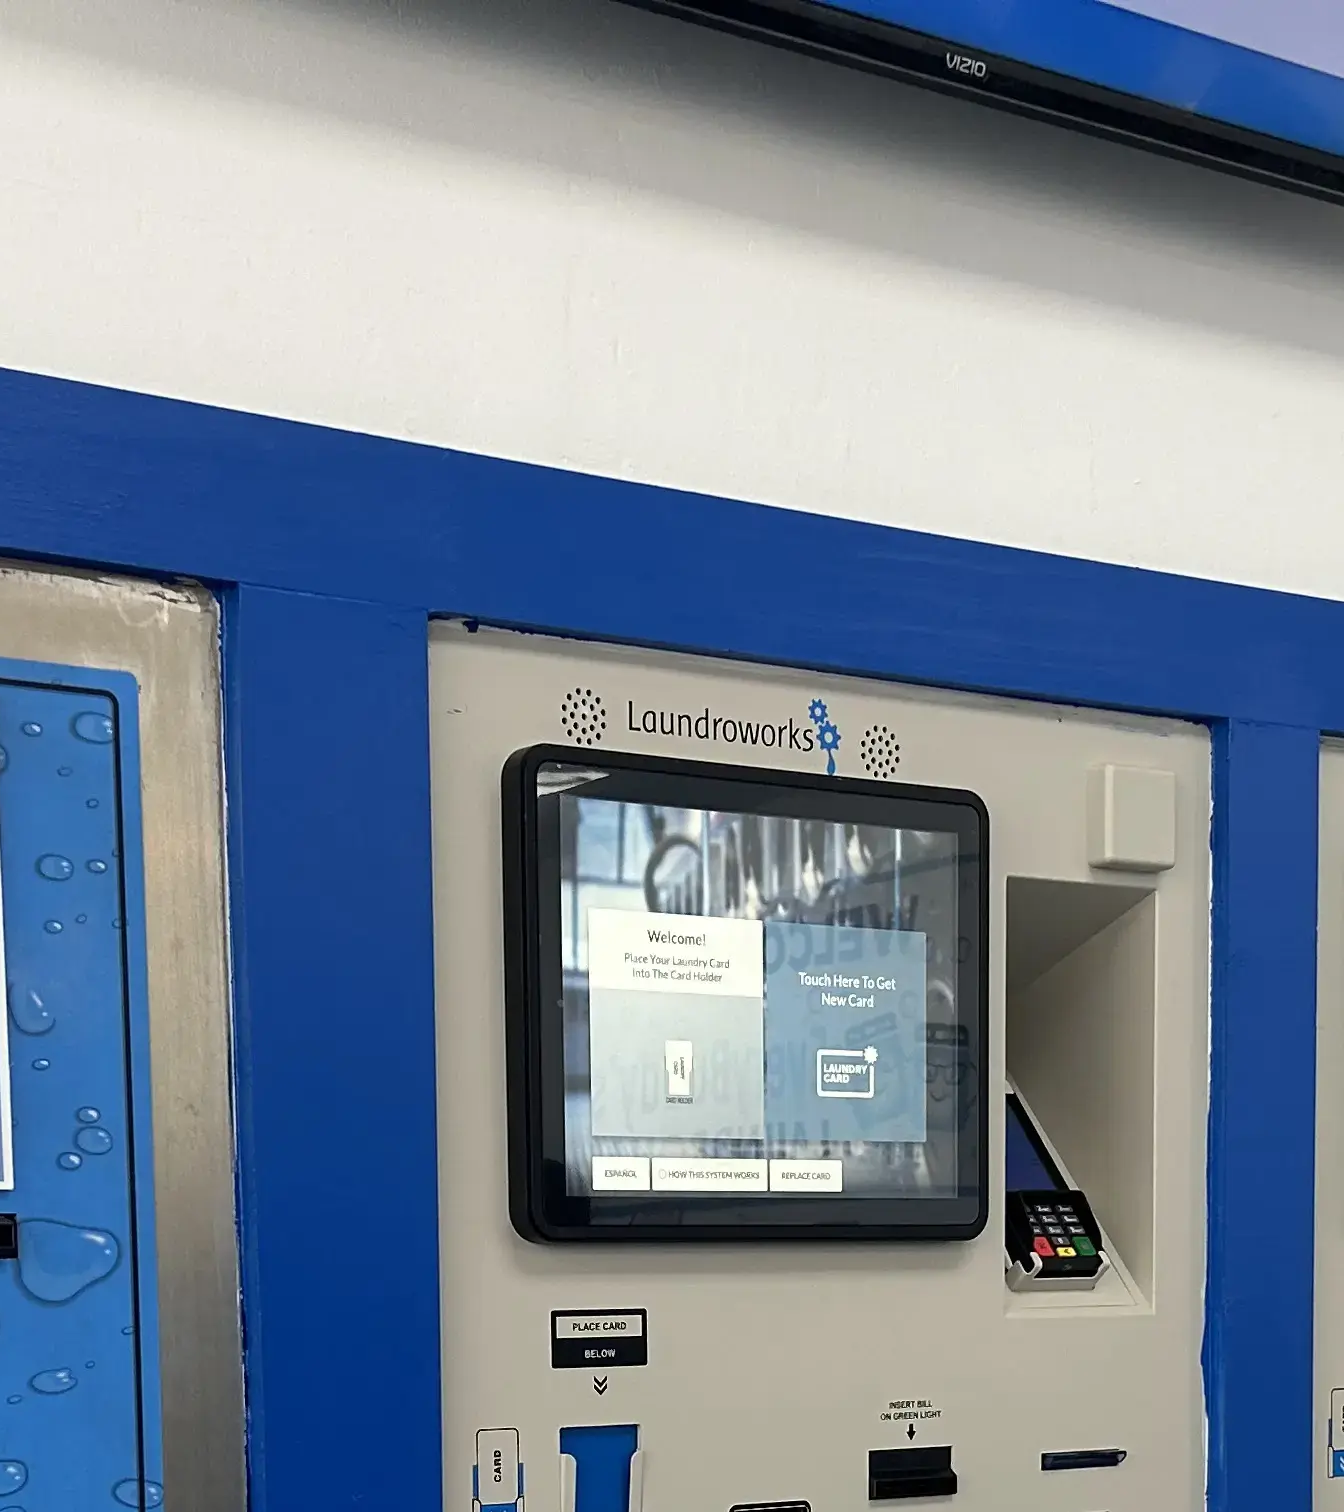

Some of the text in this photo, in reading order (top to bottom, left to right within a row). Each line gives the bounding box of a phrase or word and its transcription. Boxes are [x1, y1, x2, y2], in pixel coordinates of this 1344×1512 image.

[946, 52, 986, 77] VIZIO
[627, 700, 814, 753] Laundroworks
[647, 929, 706, 946] Welcome!
[624, 953, 730, 969] Place Your Laundry Card
[632, 968, 722, 982] Into The Card Holder
[798, 971, 896, 991] Touch Here To Get
[821, 993, 874, 1008] New Card
[823, 1063, 868, 1075] LAUNDRY
[823, 1074, 850, 1084] CARD
[668, 1171, 760, 1180] HOW THIS SYSTEM WORKS
[781, 1172, 831, 1180] REPLACE CARD
[573, 1321, 627, 1331] PLACE CARD
[584, 1349, 616, 1359] BELOW
[889, 1400, 932, 1409] INSERT BILL
[893, 1412, 919, 1420] GREEN
[920, 1411, 941, 1419] LIGHT
[494, 1449, 502, 1483] CARD
